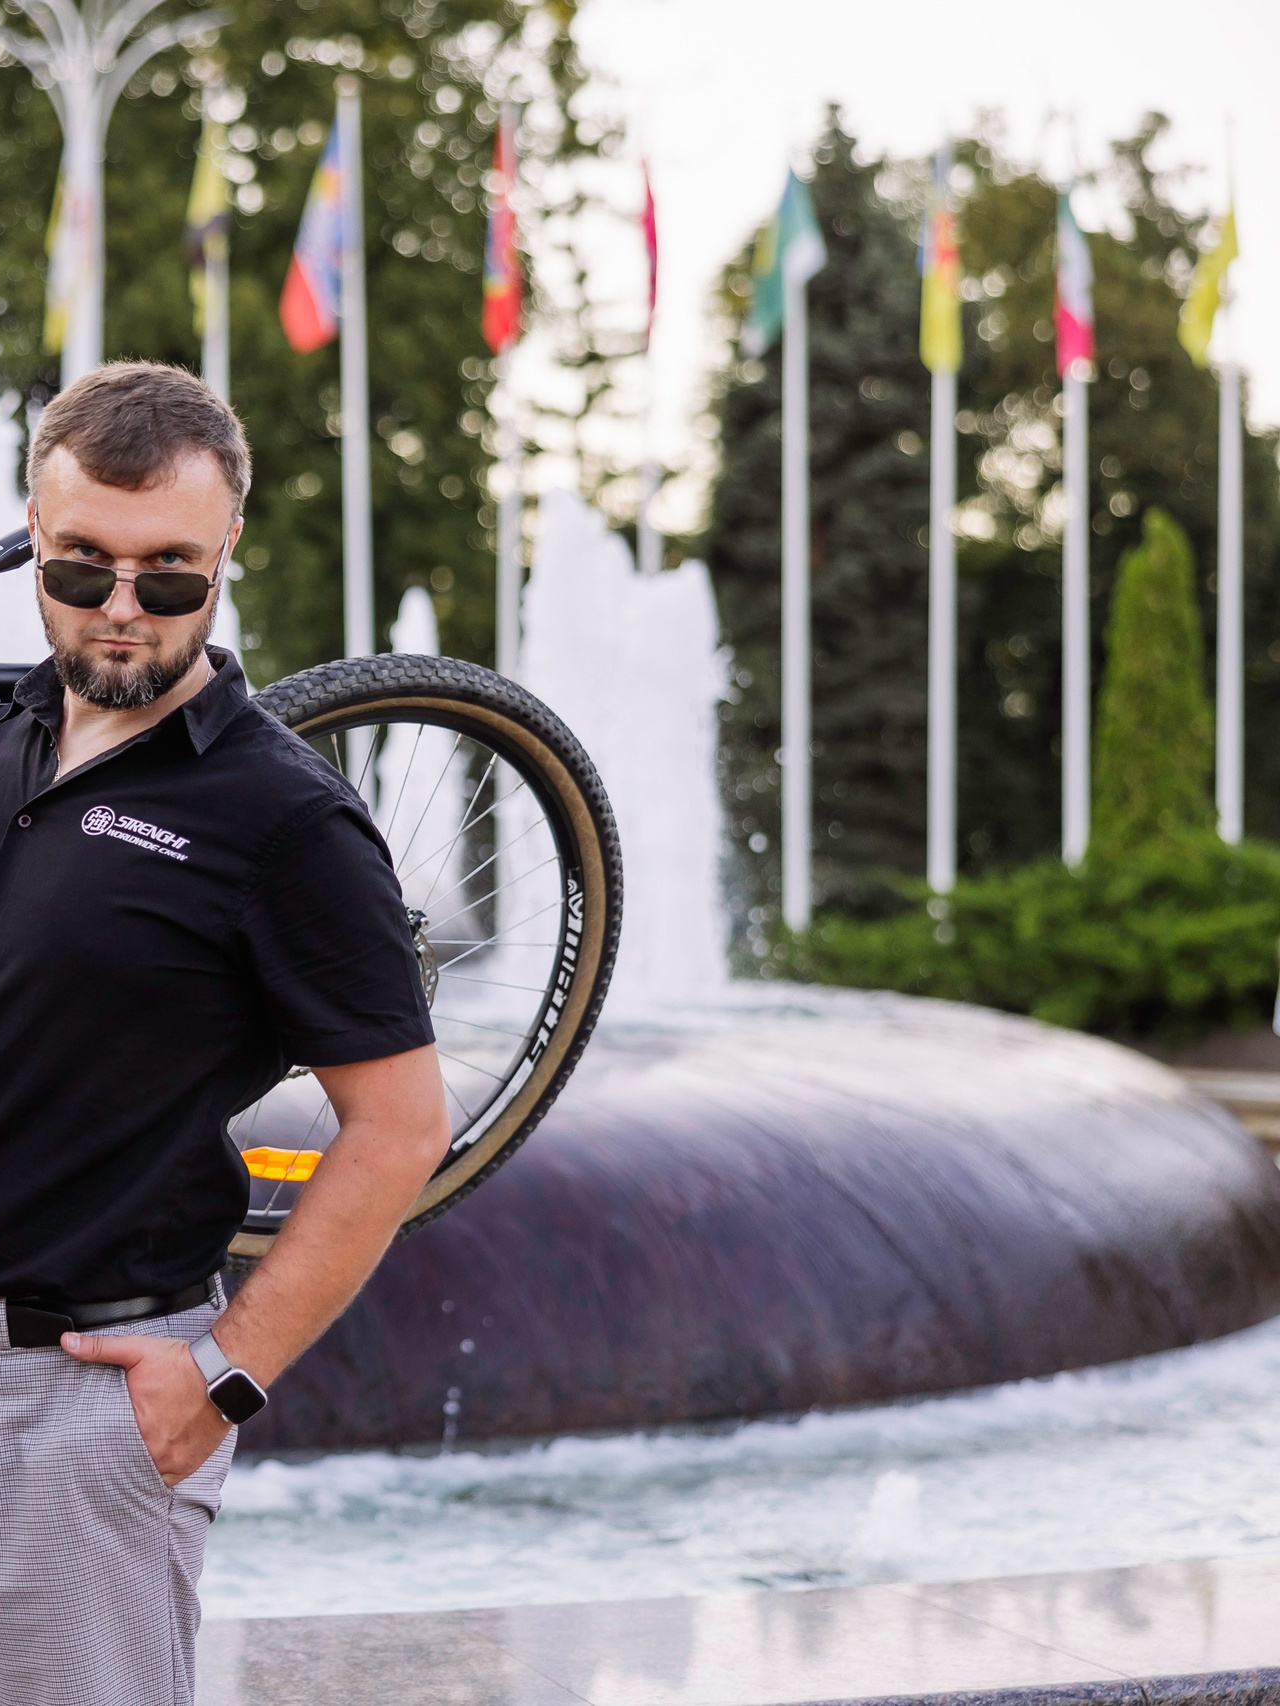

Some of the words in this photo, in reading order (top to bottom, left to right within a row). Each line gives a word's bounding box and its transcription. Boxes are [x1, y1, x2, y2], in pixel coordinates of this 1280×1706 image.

[106, 828, 159, 852] WORLDWIDE
[158, 847, 189, 861] CREW
[114, 815, 191, 850] STRENGHT
